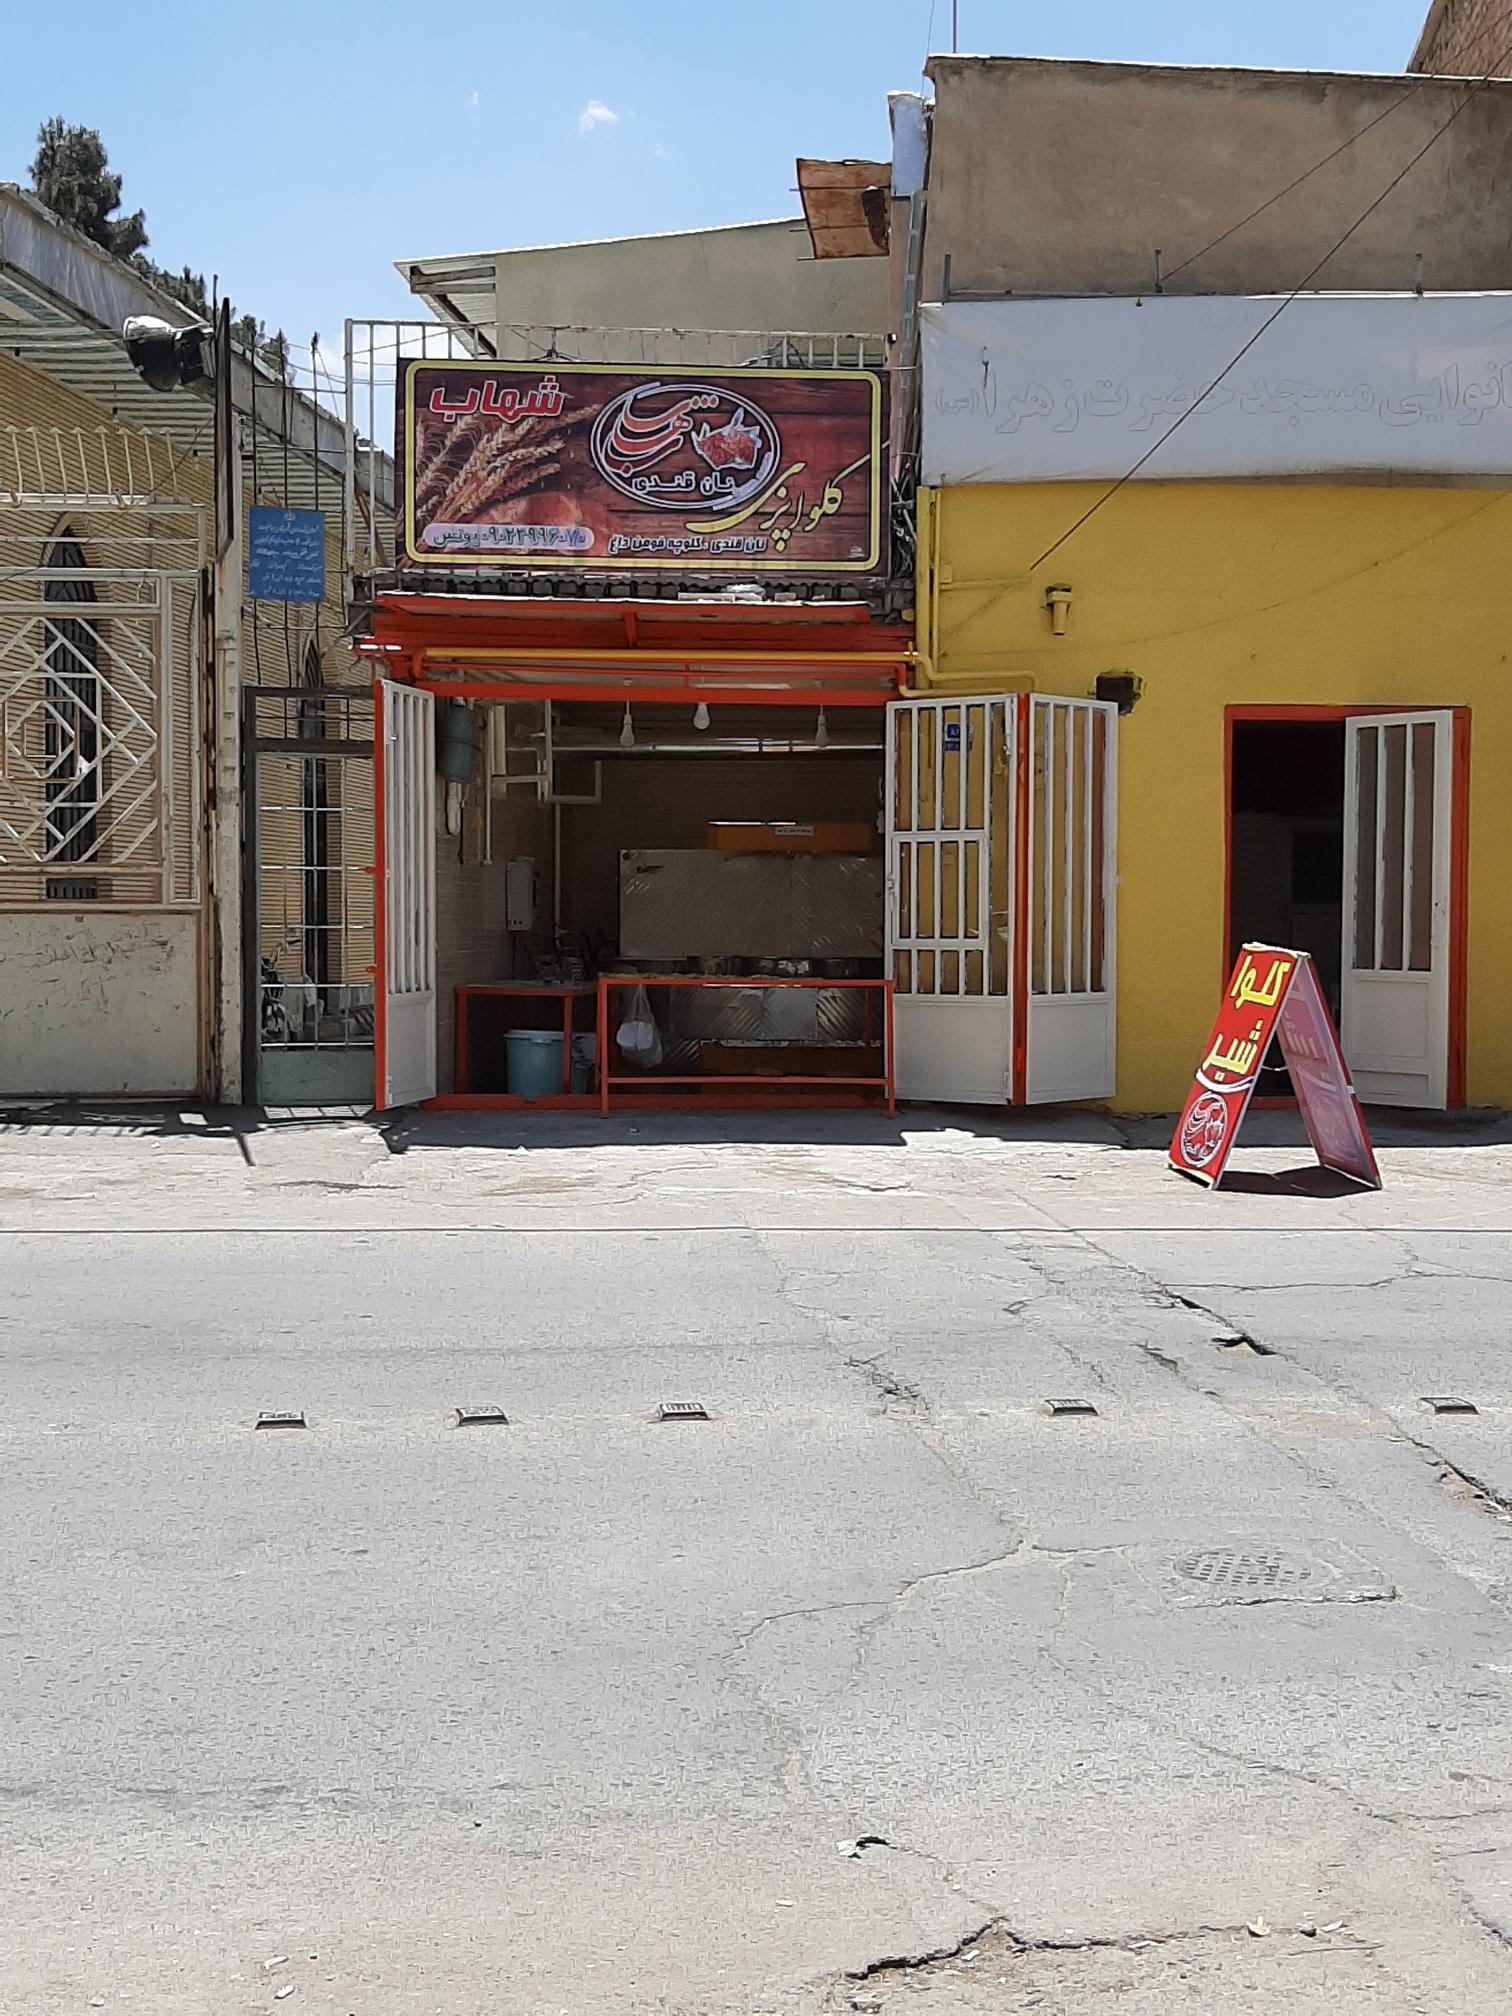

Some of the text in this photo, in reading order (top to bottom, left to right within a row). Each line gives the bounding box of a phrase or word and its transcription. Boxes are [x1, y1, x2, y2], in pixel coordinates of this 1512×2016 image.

[430, 375, 565, 424] شهاب
[632, 470, 735, 496] نان قندی
[608, 534, 631, 555] داغ
[667, 535, 702, 555] کلوچه
[710, 536, 742, 554] قندی
[744, 535, 768, 553] نان
[1230, 955, 1290, 1009] کلوا
